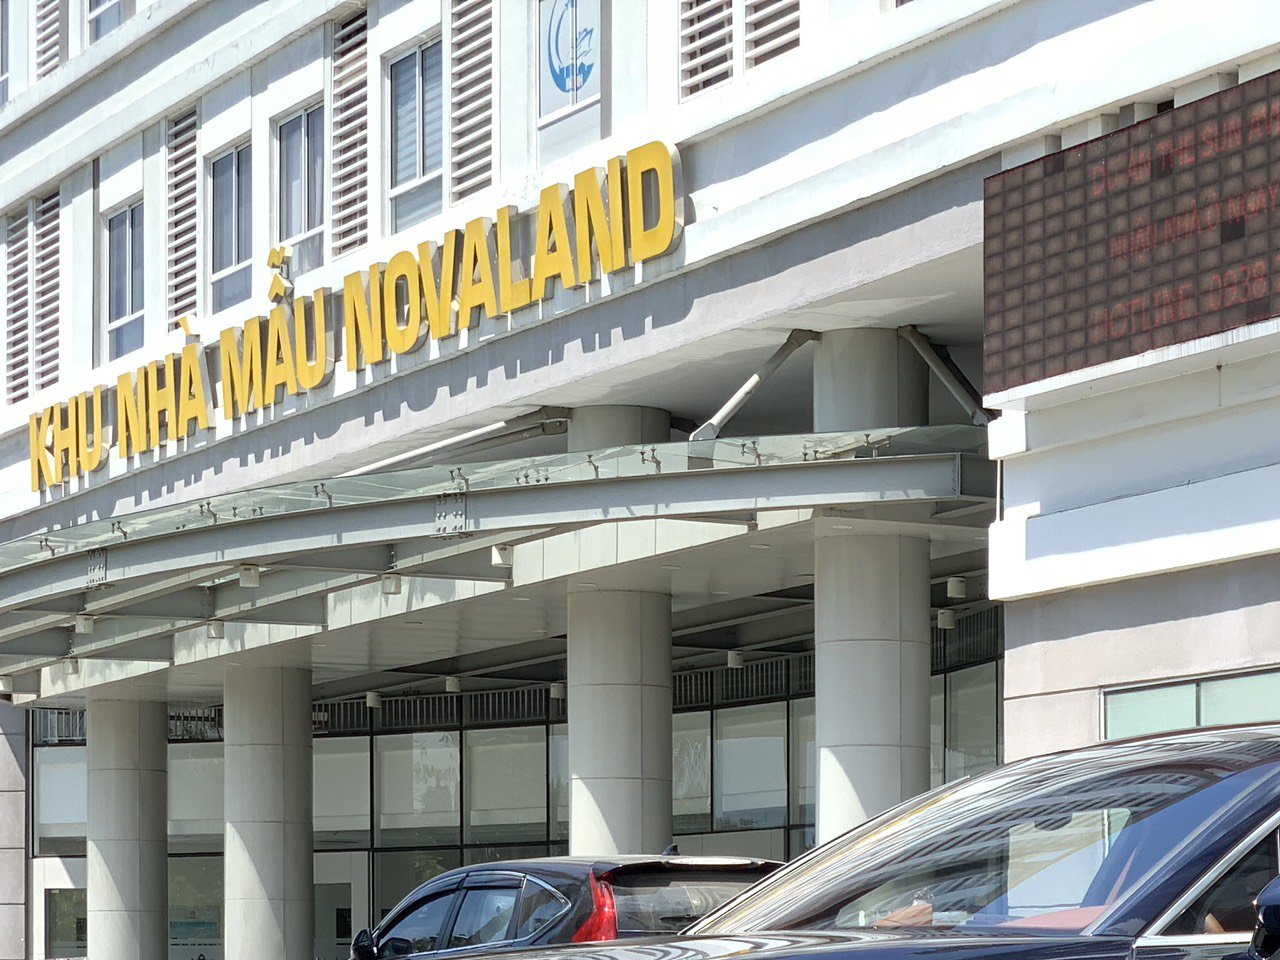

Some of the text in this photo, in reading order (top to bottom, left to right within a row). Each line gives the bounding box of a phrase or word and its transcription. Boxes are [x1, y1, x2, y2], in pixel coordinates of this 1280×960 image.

[30, 140, 683, 493] KHU NHÀ MẪU NOVALAND
